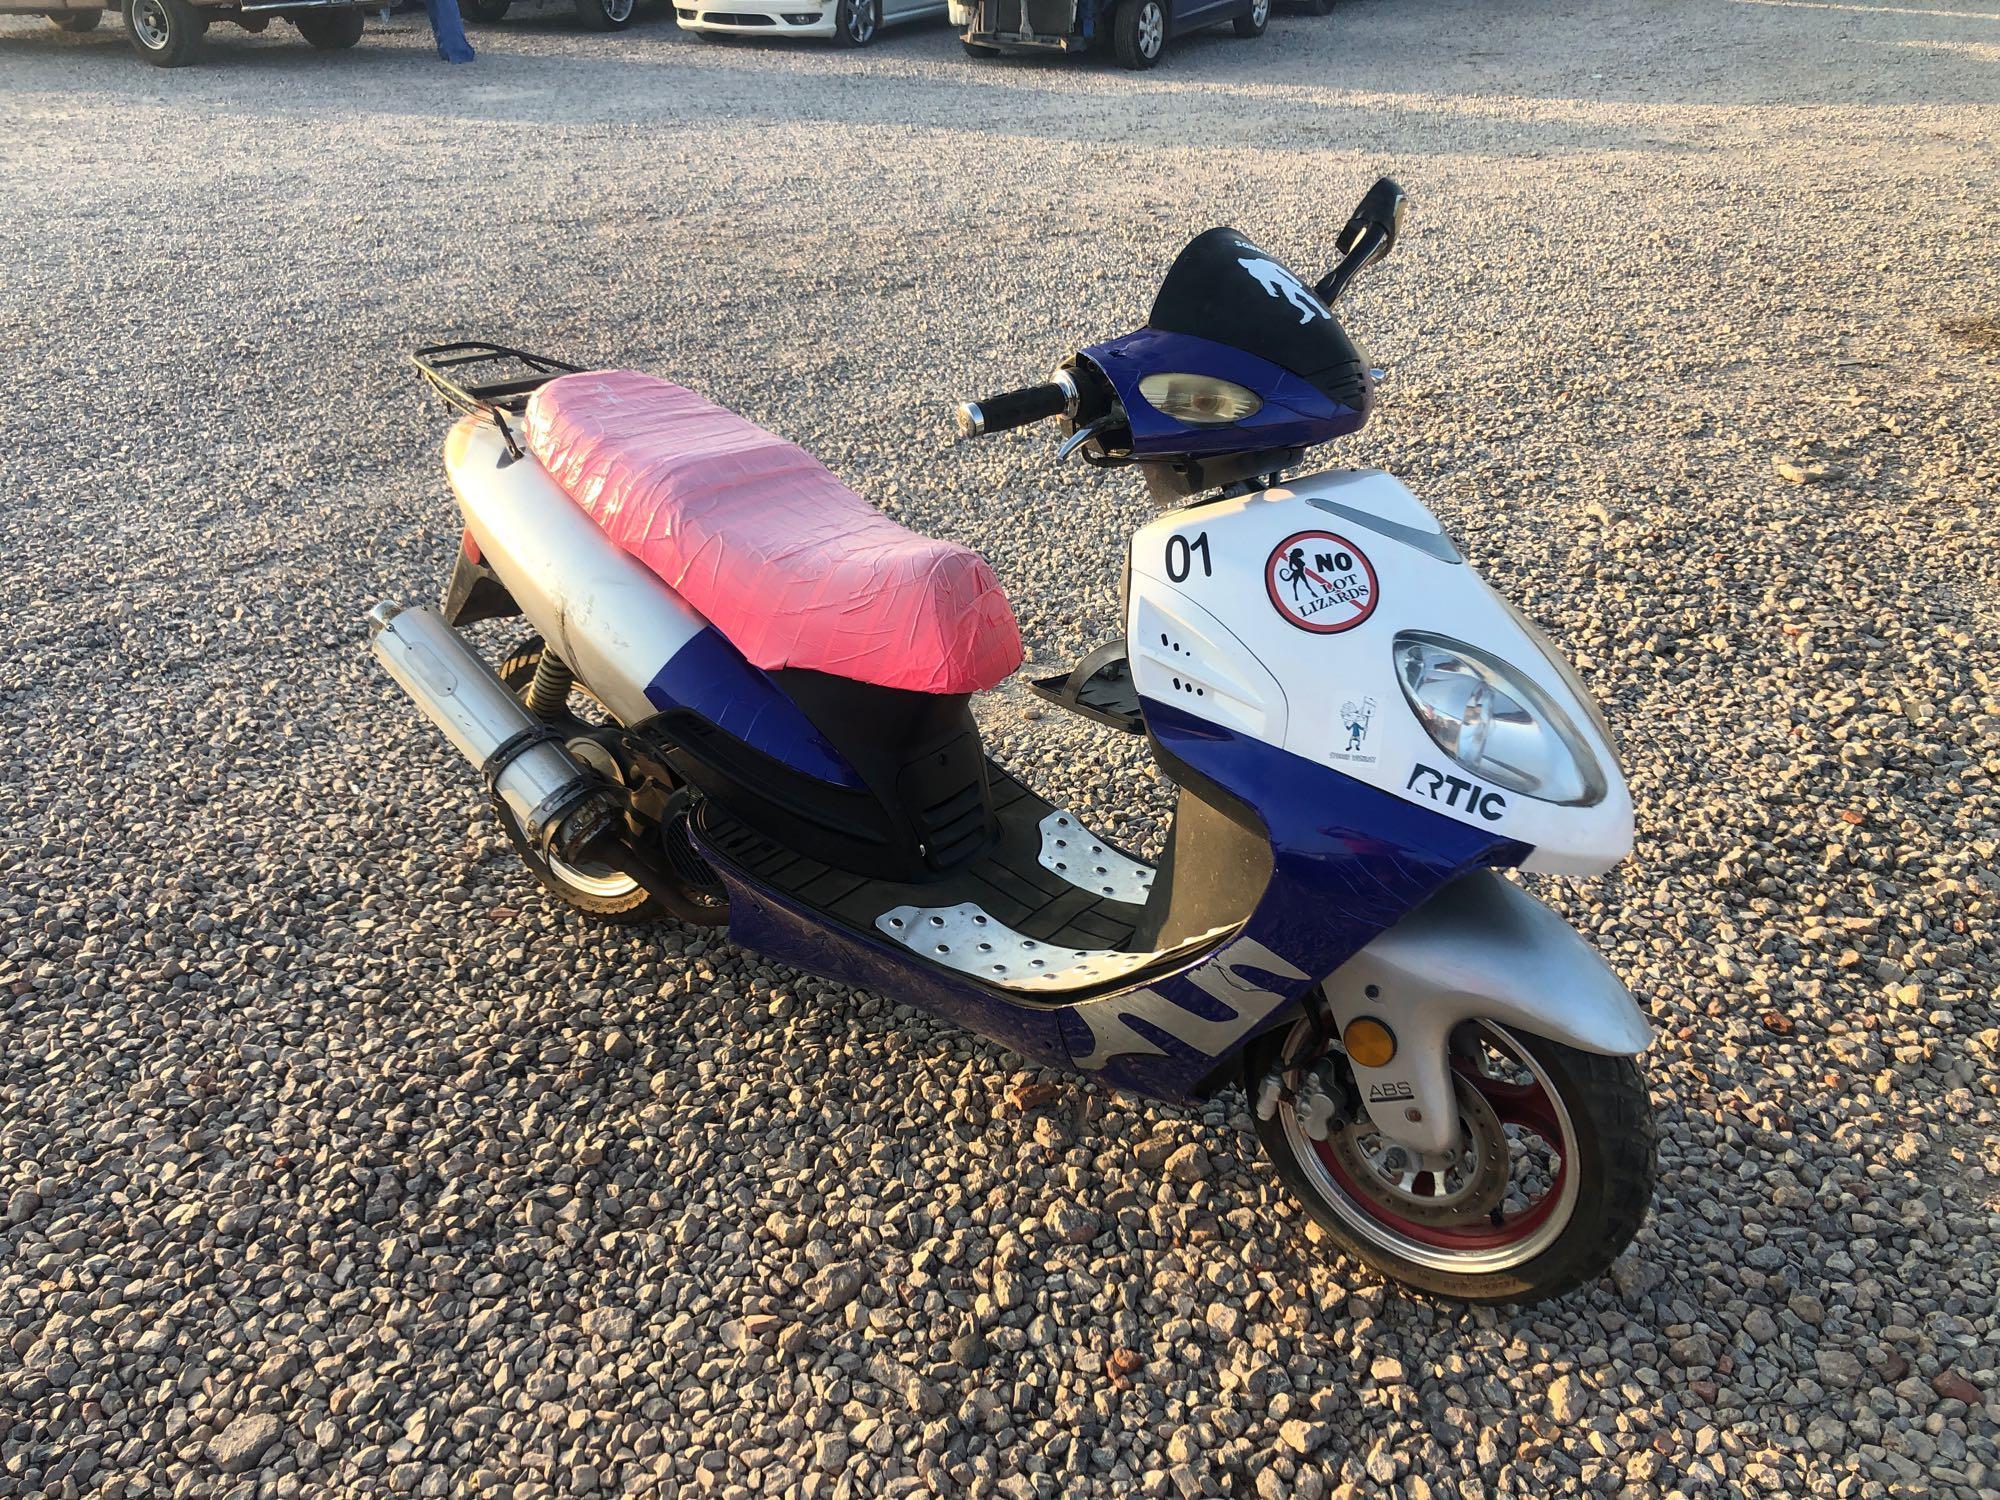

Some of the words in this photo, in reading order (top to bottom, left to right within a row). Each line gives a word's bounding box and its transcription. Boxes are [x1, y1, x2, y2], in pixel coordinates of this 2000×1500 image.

[1165, 531, 1212, 583] 01
[1315, 552, 1353, 573] NO
[1321, 573, 1359, 595] LOT
[1298, 584, 1369, 618] LIZARDS
[1406, 762, 1507, 821] RTIC
[1369, 1081, 1413, 1098] ABS
